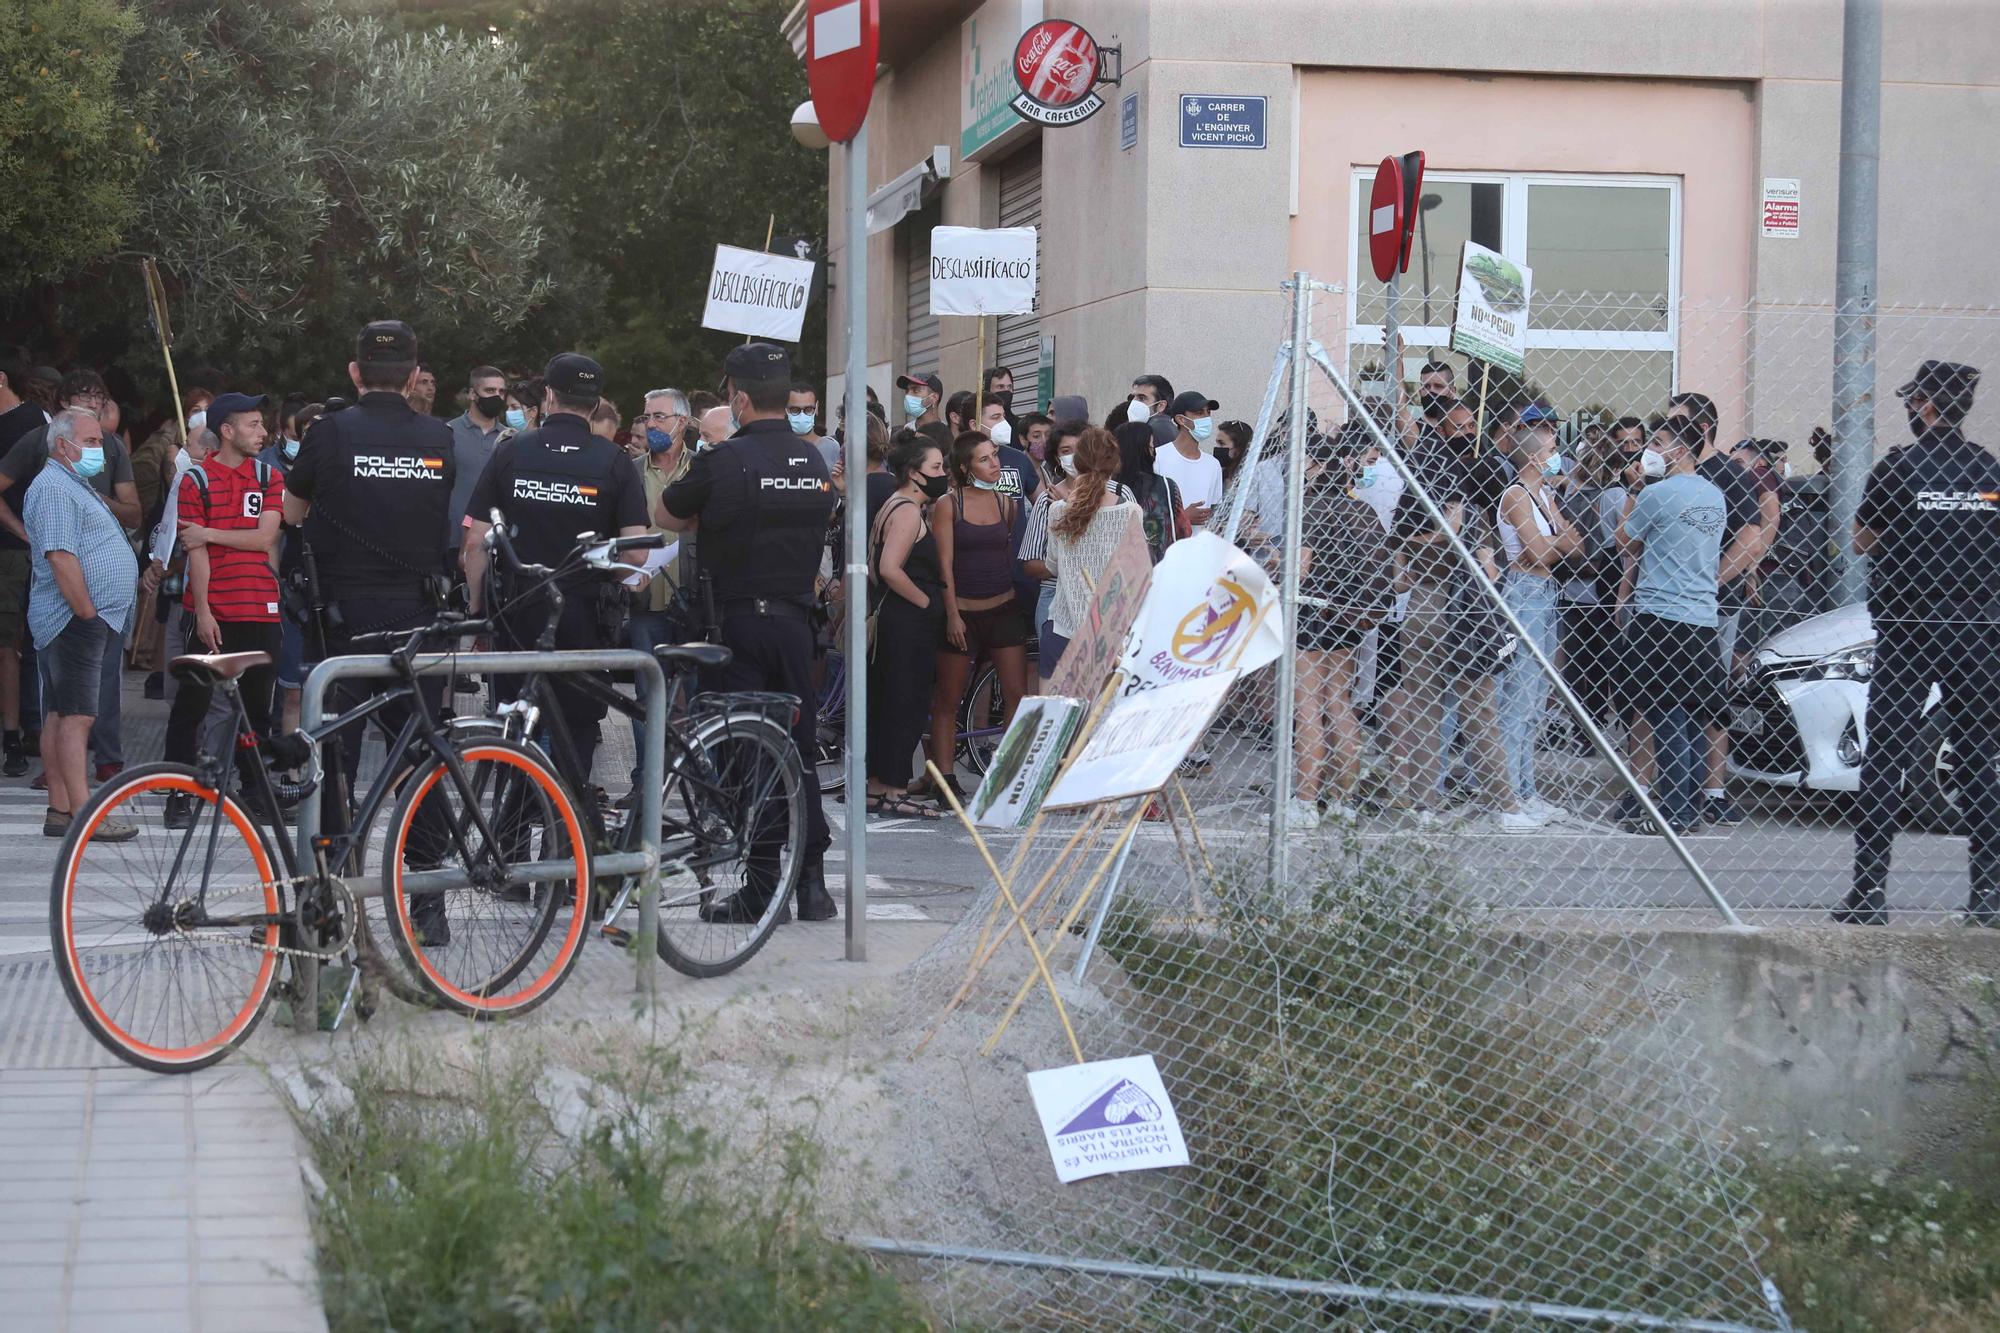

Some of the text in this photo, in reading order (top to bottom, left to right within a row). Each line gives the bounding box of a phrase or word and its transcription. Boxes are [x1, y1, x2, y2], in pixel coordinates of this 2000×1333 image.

[1019, 27, 1053, 75] Coca-Cola
[1019, 100, 1041, 117] BAR
[1045, 99, 1097, 122] CAFETERIA
[1208, 103, 1246, 112] CARRER
[1217, 113, 1230, 122] DE
[1196, 123, 1251, 132] L'ENGINYER
[1191, 132, 1225, 141] VICENT
[1766, 203, 1797, 211] Alarma
[1470, 305, 1484, 323] NO
[376, 335, 395, 343] CNP
[768, 353, 783, 361] CNP
[578, 372, 595, 380] CNP
[354, 455, 425, 468] POLICIA
[354, 467, 442, 480] NACIONAL
[514, 479, 580, 494] POLICIA
[760, 478, 823, 490] POLICIA
[514, 489, 597, 506] NACIONAL
[1917, 491, 1981, 501] POLICIA
[248, 493, 261, 516] 9
[1917, 501, 1998, 511] NACIONAL
[1008, 781, 1025, 804] NO
[1026, 719, 1054, 765] PGOU
[1057, 1124, 1165, 1147] FEM ELS BARRIS
[1110, 1134, 1168, 1148] NOSTRA
[1080, 1142, 1099, 1152] LA
[1153, 1144, 1171, 1153] LA
